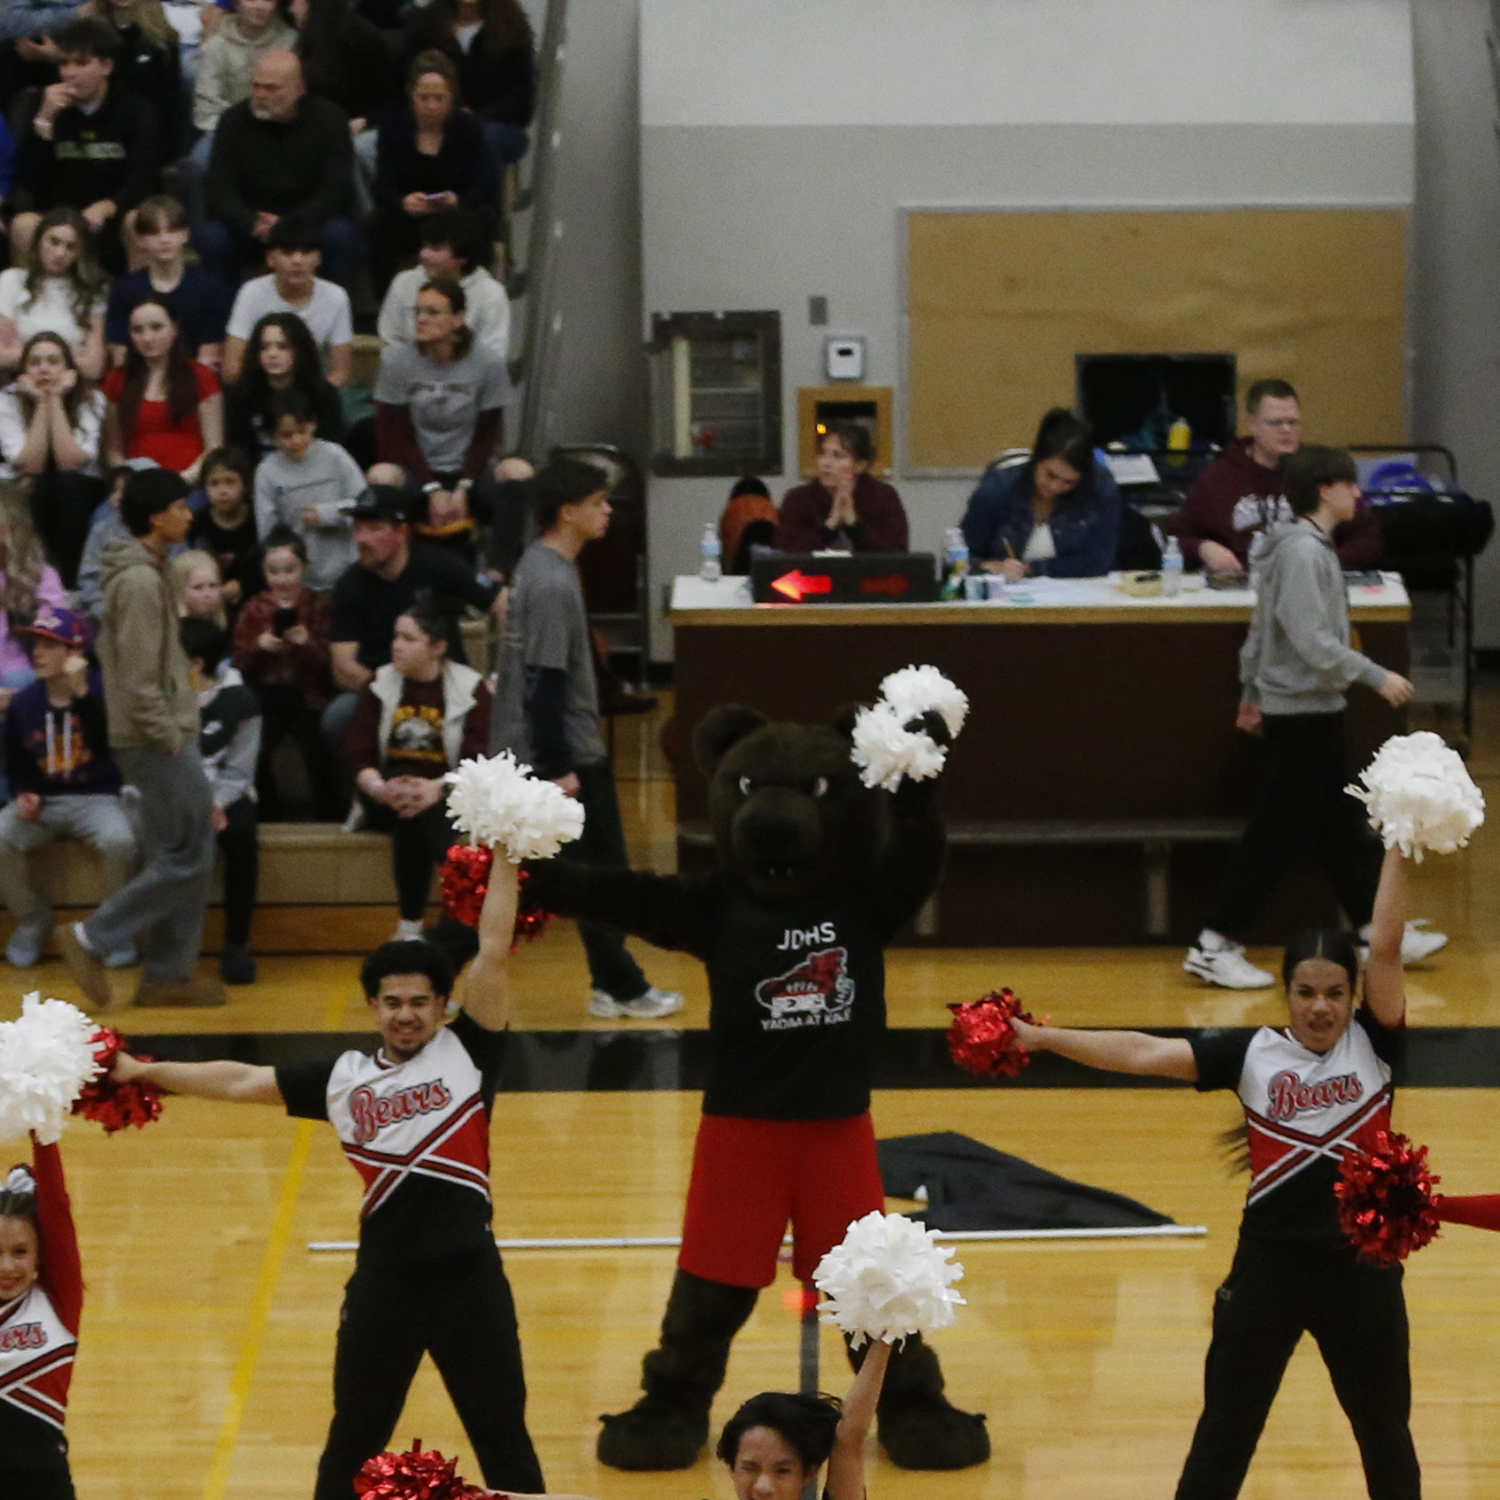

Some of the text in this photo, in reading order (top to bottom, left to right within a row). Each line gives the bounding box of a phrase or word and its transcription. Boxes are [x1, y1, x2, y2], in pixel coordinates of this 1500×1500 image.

[776, 920, 837, 951] JDHS
[349, 1078, 453, 1142] Bears
[1267, 1071, 1363, 1121] Bears
